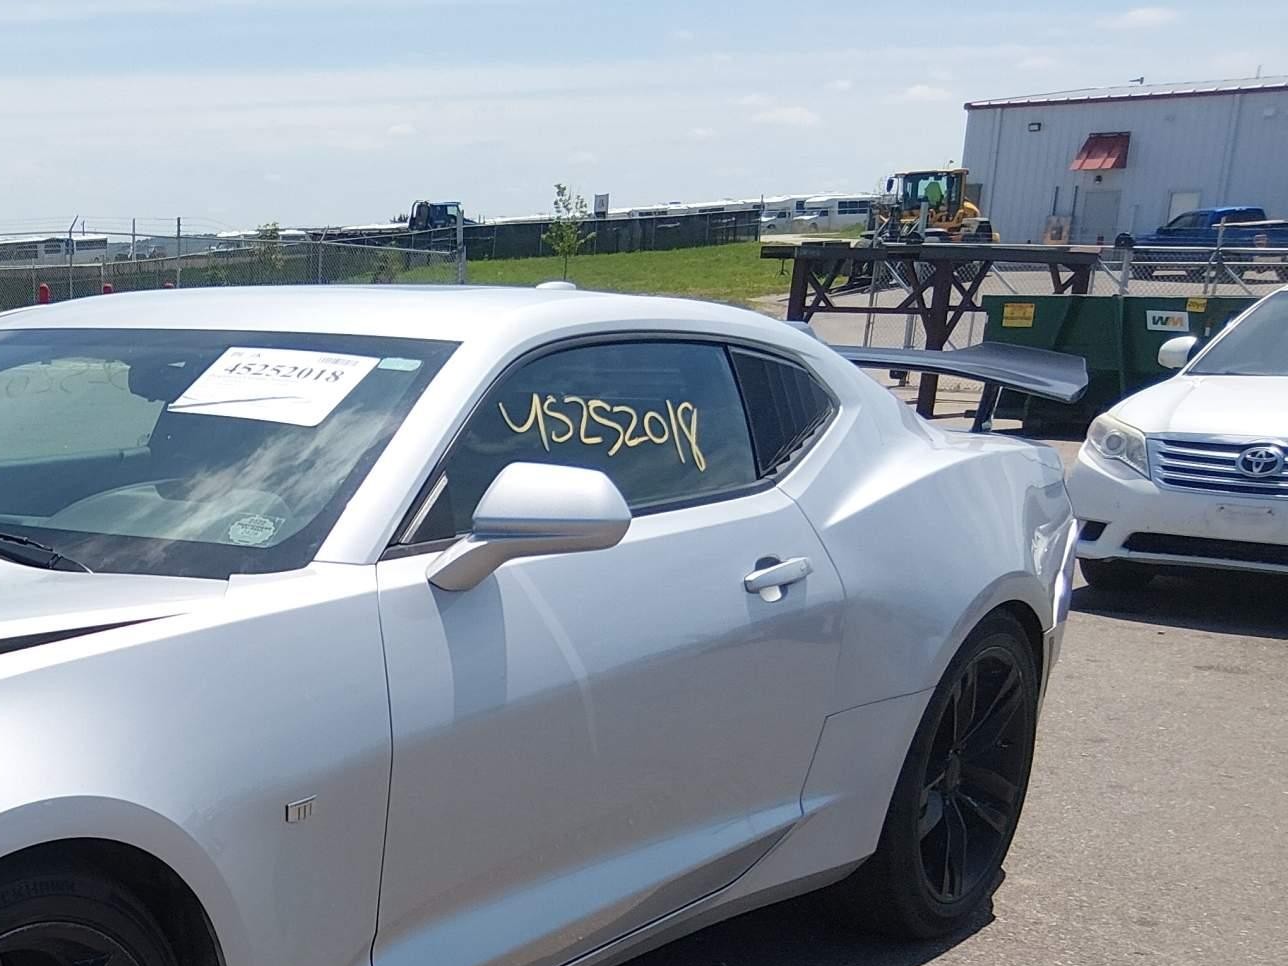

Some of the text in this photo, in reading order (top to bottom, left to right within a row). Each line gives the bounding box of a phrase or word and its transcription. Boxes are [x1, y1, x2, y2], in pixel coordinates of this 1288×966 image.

[1152, 316, 1184, 326] WM
[224, 361, 345, 384] 45252018
[498, 393, 706, 472] 45252018
